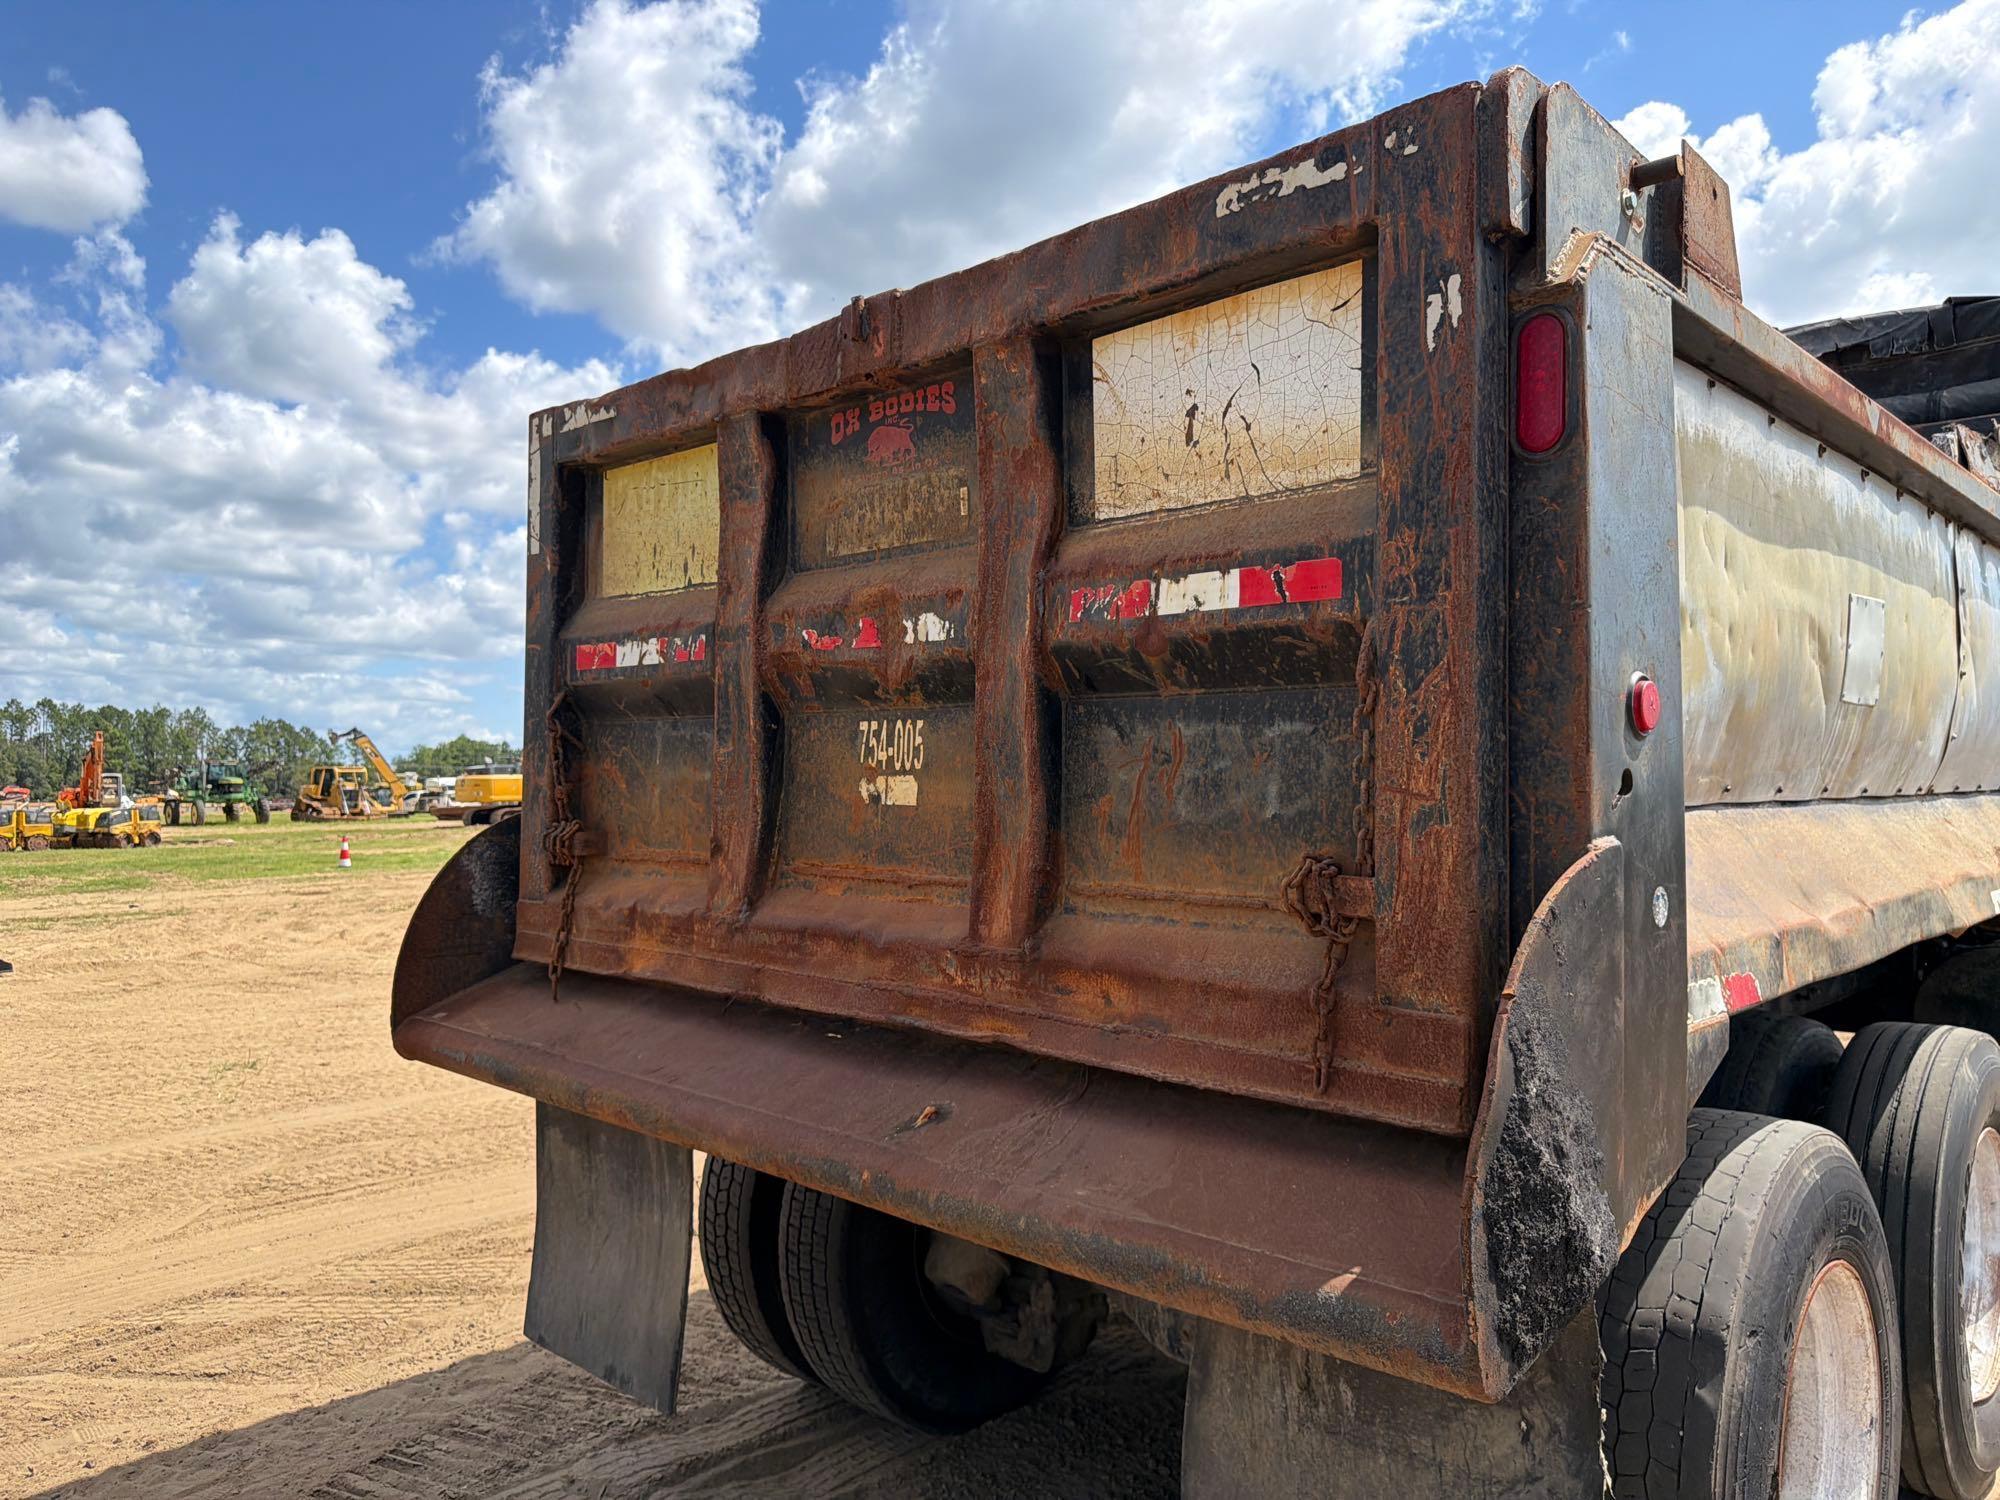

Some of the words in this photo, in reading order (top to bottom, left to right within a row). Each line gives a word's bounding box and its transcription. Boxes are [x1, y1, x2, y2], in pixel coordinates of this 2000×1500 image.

[831, 407, 860, 446] OX
[868, 381, 957, 423] BODIES
[859, 718, 924, 771] 754-005
